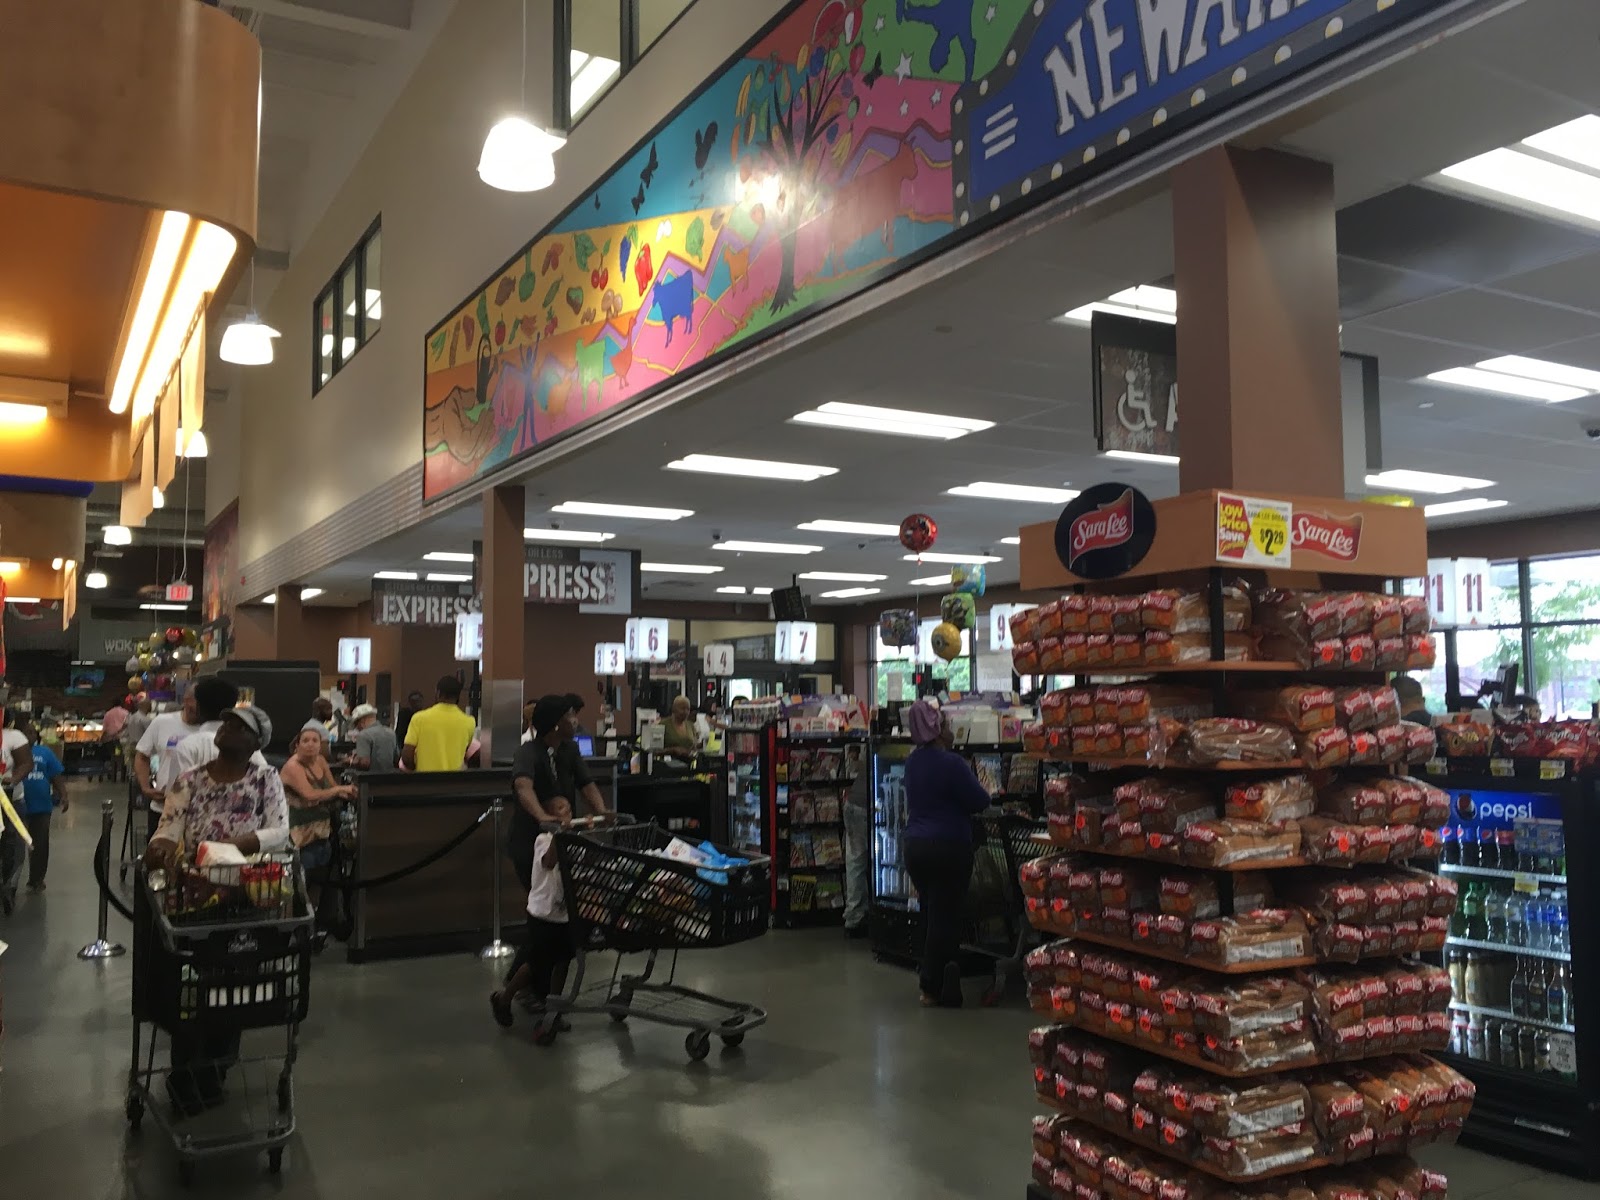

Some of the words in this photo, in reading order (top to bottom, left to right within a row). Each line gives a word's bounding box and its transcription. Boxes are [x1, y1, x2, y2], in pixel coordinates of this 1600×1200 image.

[1073, 520, 1107, 550] Sara
[1104, 512, 1129, 539] Lee
[1292, 517, 1328, 545] Sara
[1327, 527, 1353, 556] Lee
[524, 562, 606, 602] PRESS
[1462, 573, 1483, 612] 11
[647, 627, 659, 651] 6
[997, 613, 1006, 642] 9
[799, 630, 809, 654] 7
[352, 646, 360, 665] 1
[610, 652, 618, 667] 3
[720, 650, 728, 668] 4
[1480, 802, 1533, 822] pepsi
